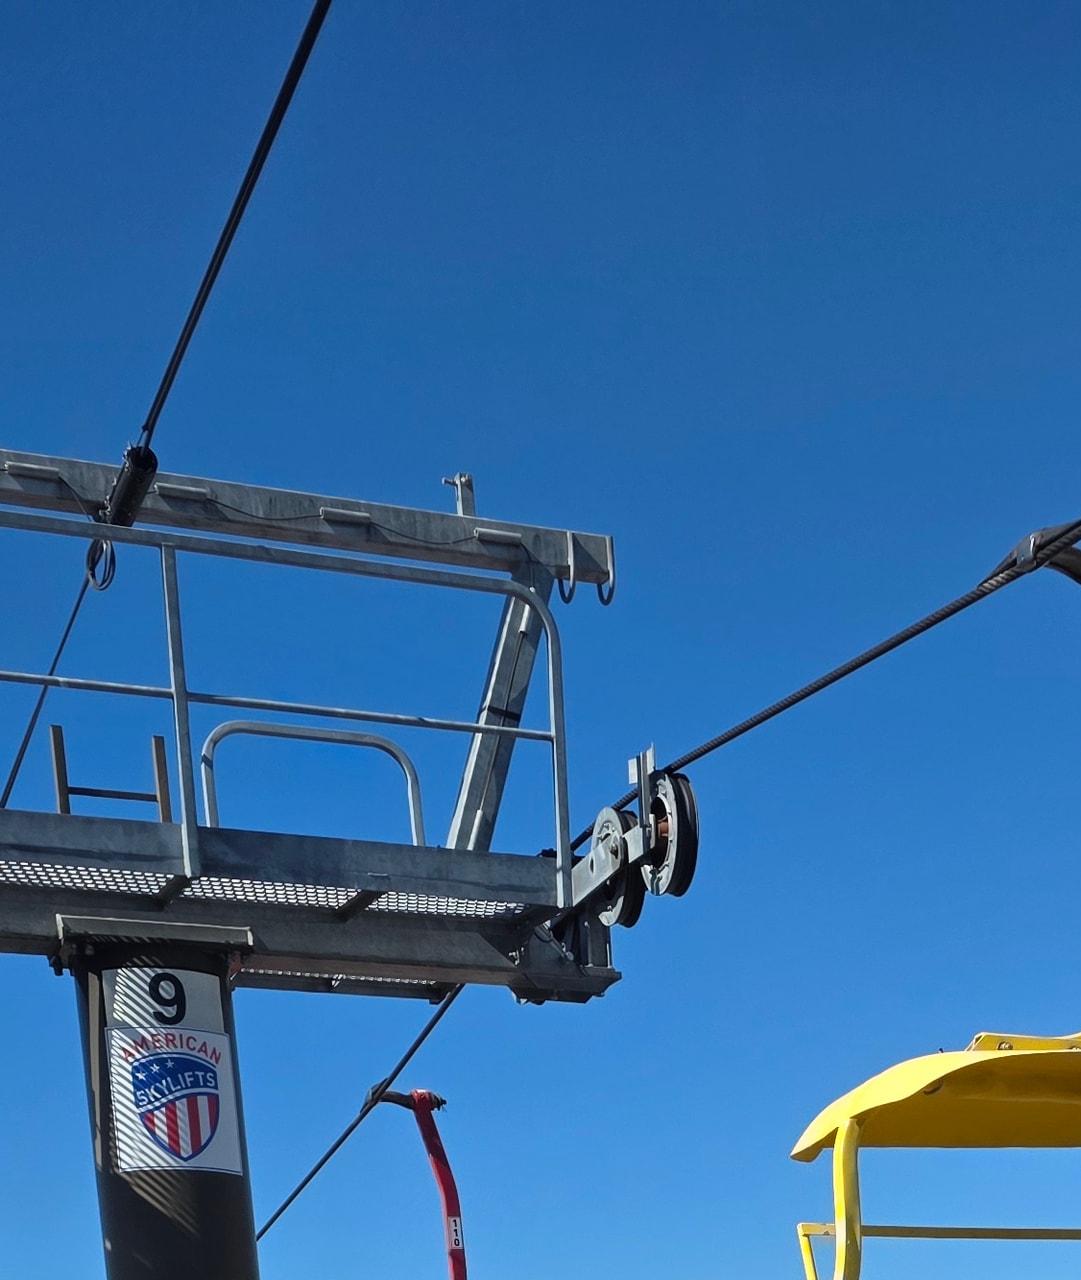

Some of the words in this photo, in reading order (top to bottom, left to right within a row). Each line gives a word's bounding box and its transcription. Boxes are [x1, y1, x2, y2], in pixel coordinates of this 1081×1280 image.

[149, 971, 188, 1026] 9
[121, 1032, 222, 1066] AMERICAN
[135, 1071, 217, 1107] SKYLIFTS
[452, 1219, 460, 1247] 110
